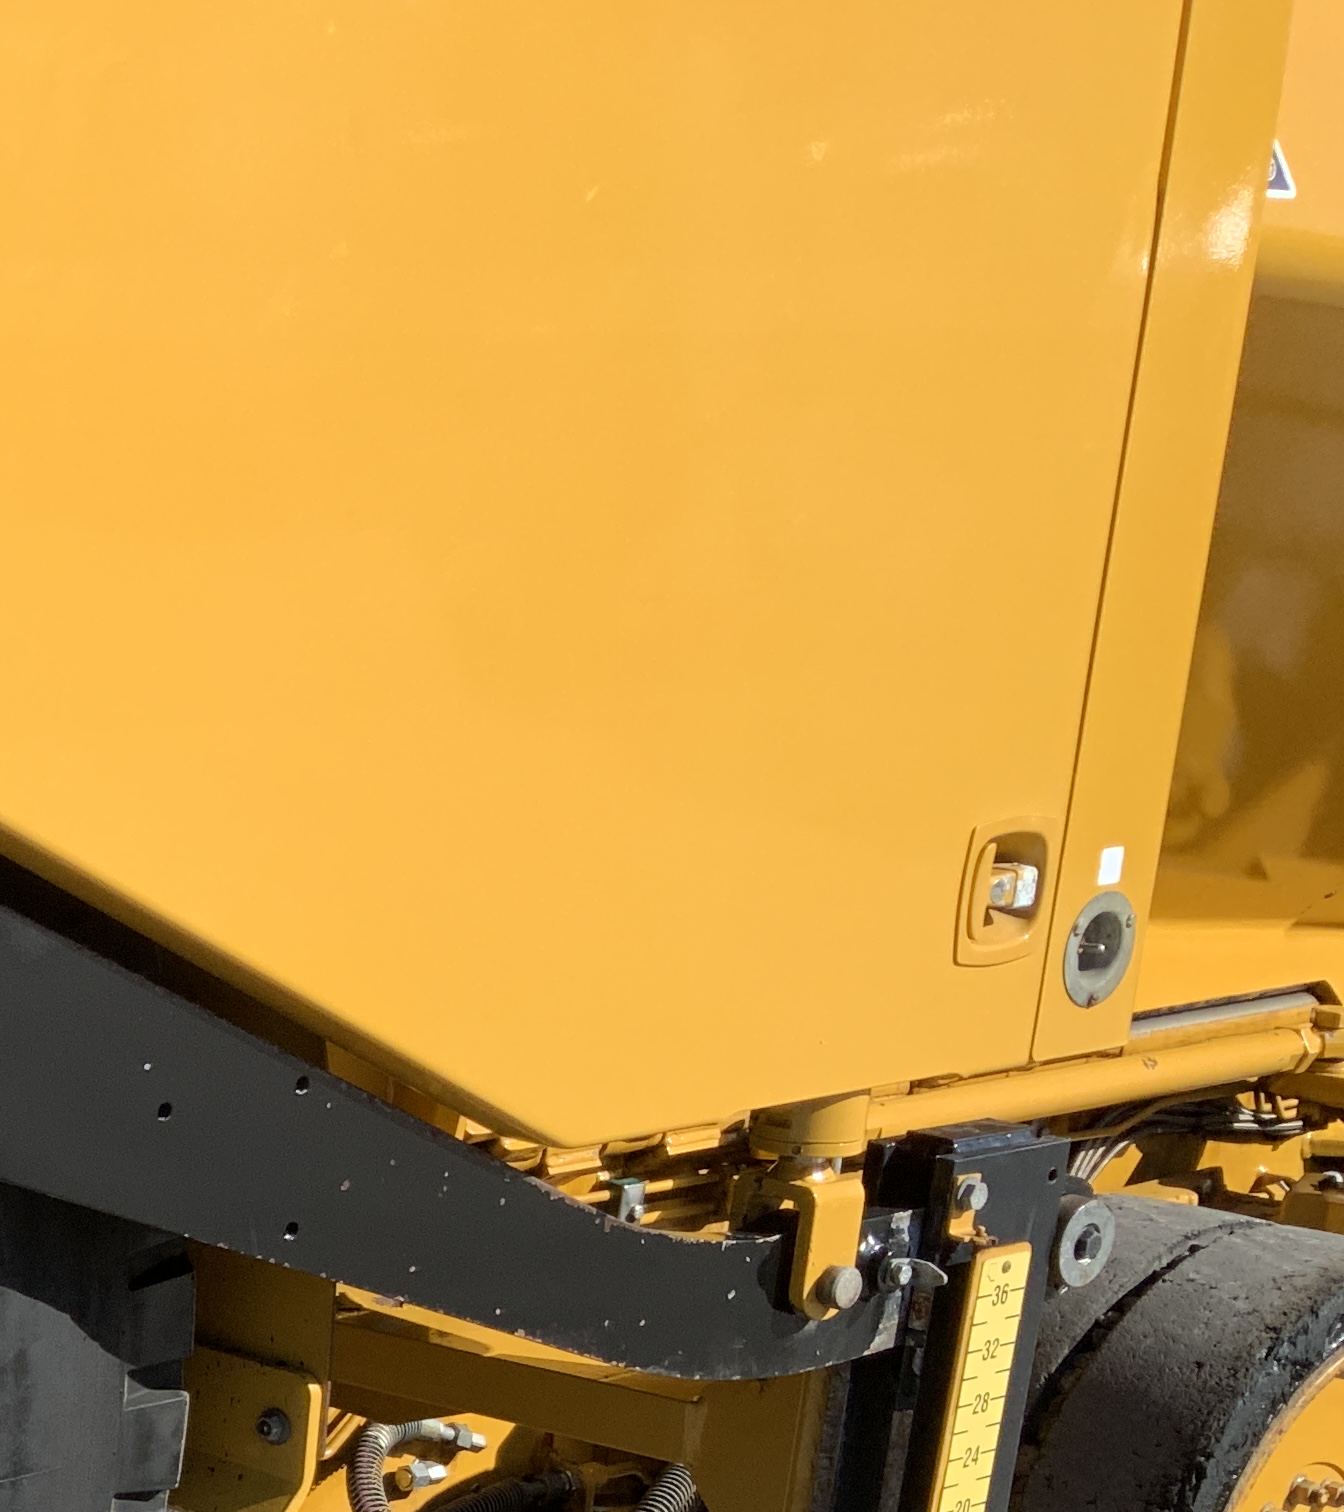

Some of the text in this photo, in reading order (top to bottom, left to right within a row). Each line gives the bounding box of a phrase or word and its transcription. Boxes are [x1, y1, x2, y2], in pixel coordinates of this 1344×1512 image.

[991, 1283, 1010, 1306] 36
[981, 1337, 1000, 1360] 32
[971, 1392, 990, 1414] 28
[962, 1445, 980, 1469] 24
